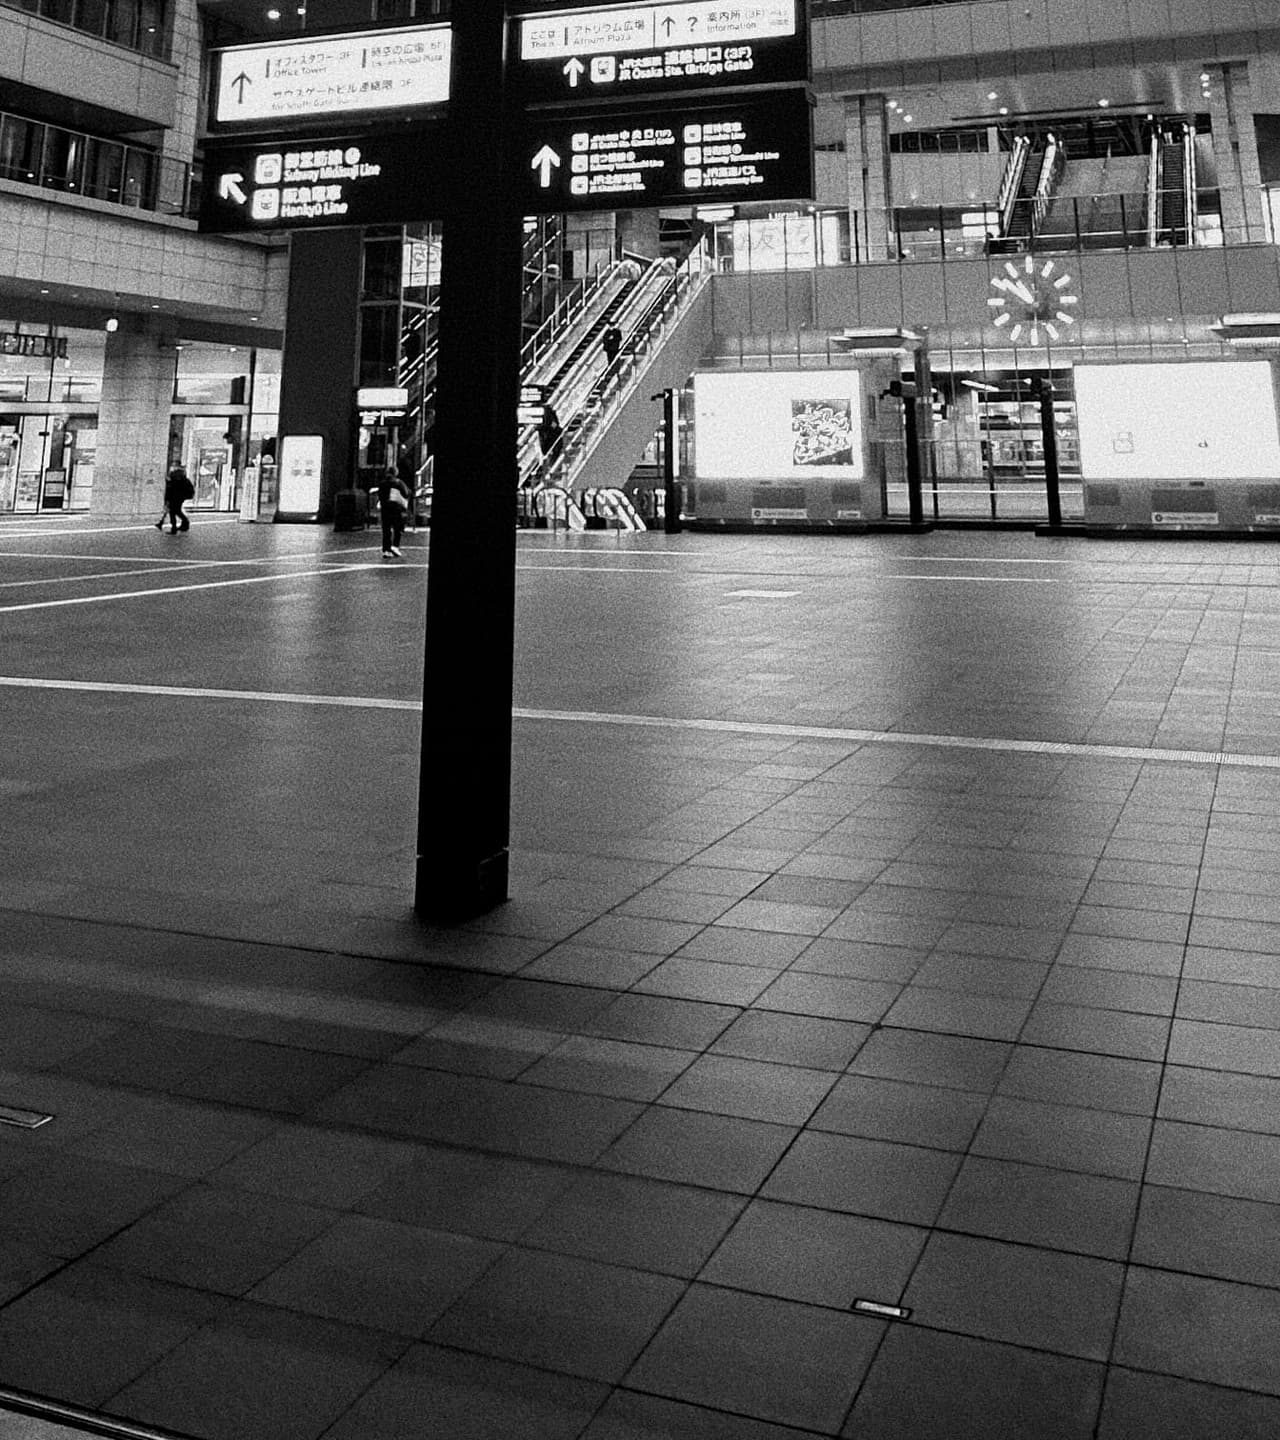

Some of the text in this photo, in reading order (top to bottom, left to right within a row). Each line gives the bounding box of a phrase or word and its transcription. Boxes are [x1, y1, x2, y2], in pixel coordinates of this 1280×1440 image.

[707, 22, 757, 33] Information
[723, 46, 753, 60] (3F)
[618, 69, 631, 81] JR
[664, 65, 684, 78] Sta.
[685, 61, 723, 76] (Bridge
[359, 162, 381, 177] Line
[323, 201, 348, 216] Line
